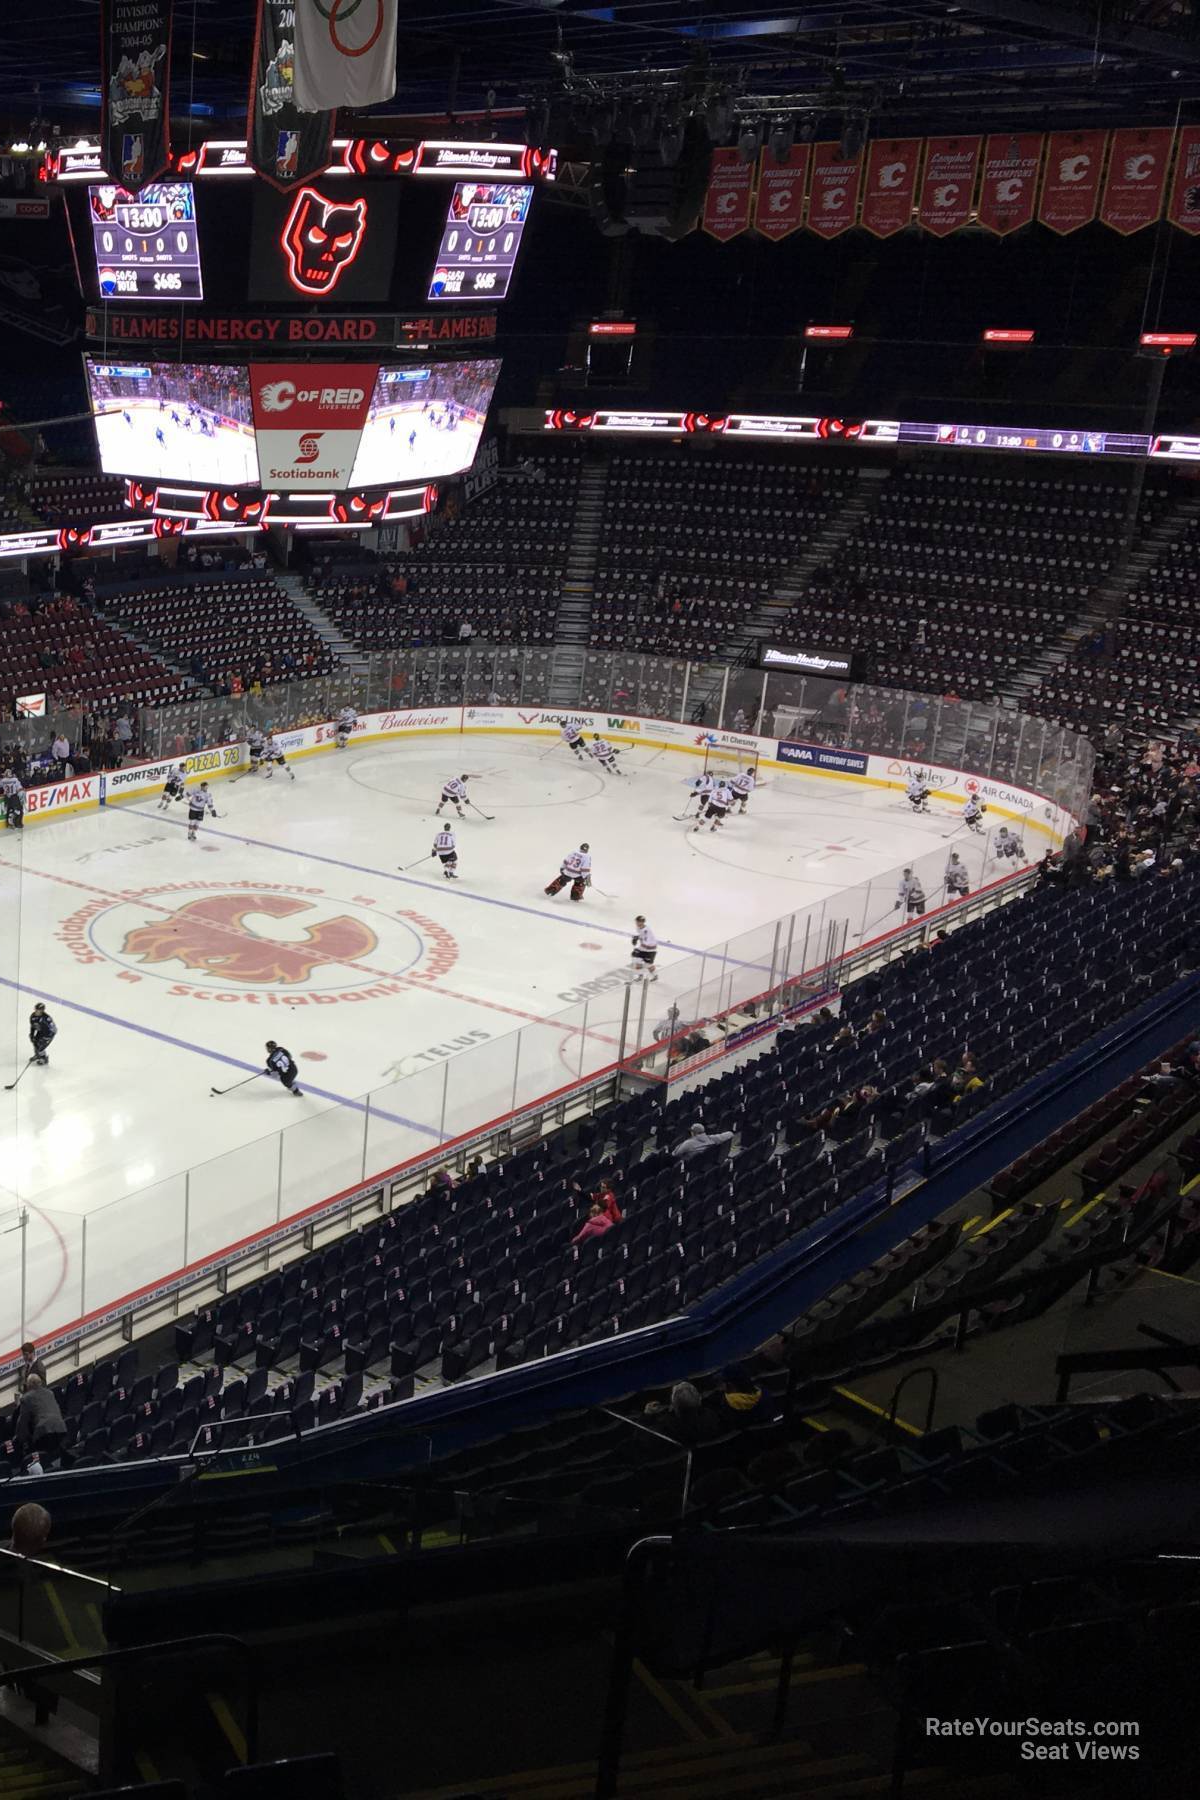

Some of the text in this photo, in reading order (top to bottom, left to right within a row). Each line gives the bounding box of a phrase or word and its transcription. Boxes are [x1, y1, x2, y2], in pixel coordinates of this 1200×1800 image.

[116, 3, 159, 18] DIVISION
[110, 18, 164, 33] CHAMPIONS
[122, 208, 162, 228] 13:00
[472, 207, 504, 228] 13:00
[103, 231, 113, 252] 0
[125, 238, 133, 252] 0
[156, 238, 164, 252] 0
[177, 231, 188, 253] 0
[448, 231, 458, 252] 0
[465, 238, 472, 252] 0
[488, 238, 496, 252] 0
[504, 232, 514, 253] 0
[116, 271, 182, 290] 50/50 $685
[117, 281, 138, 291] TOTAL
[474, 272, 497, 290] $685
[111, 316, 377, 341] FLAMES ENERGY BOARD
[297, 391, 320, 402] OF
[321, 388, 365, 404] RED
[976, 429, 986, 443] 0
[1053, 434, 1062, 447] 0
[269, 468, 340, 479] Scotiabank
[763, 649, 848, 670] HitmenHockey.com
[378, 711, 448, 731] Budweiser
[539, 714, 564, 723] JACK
[608, 718, 640, 730] WM
[730, 736, 758, 749] Chesney
[185, 748, 240, 775] PIZZA 73
[787, 748, 813, 760] AMA
[112, 764, 174, 786] SPORTSNET
[27, 781, 92, 812] RE/MAX
[981, 785, 1035, 810] AIR CANADA
[119, 880, 325, 899] Saddledome
[53, 897, 120, 966] Scotiabank
[397, 909, 460, 982] Saddledome
[166, 982, 409, 1008] Scotiabank
[412, 1029, 492, 1062] TELUS
